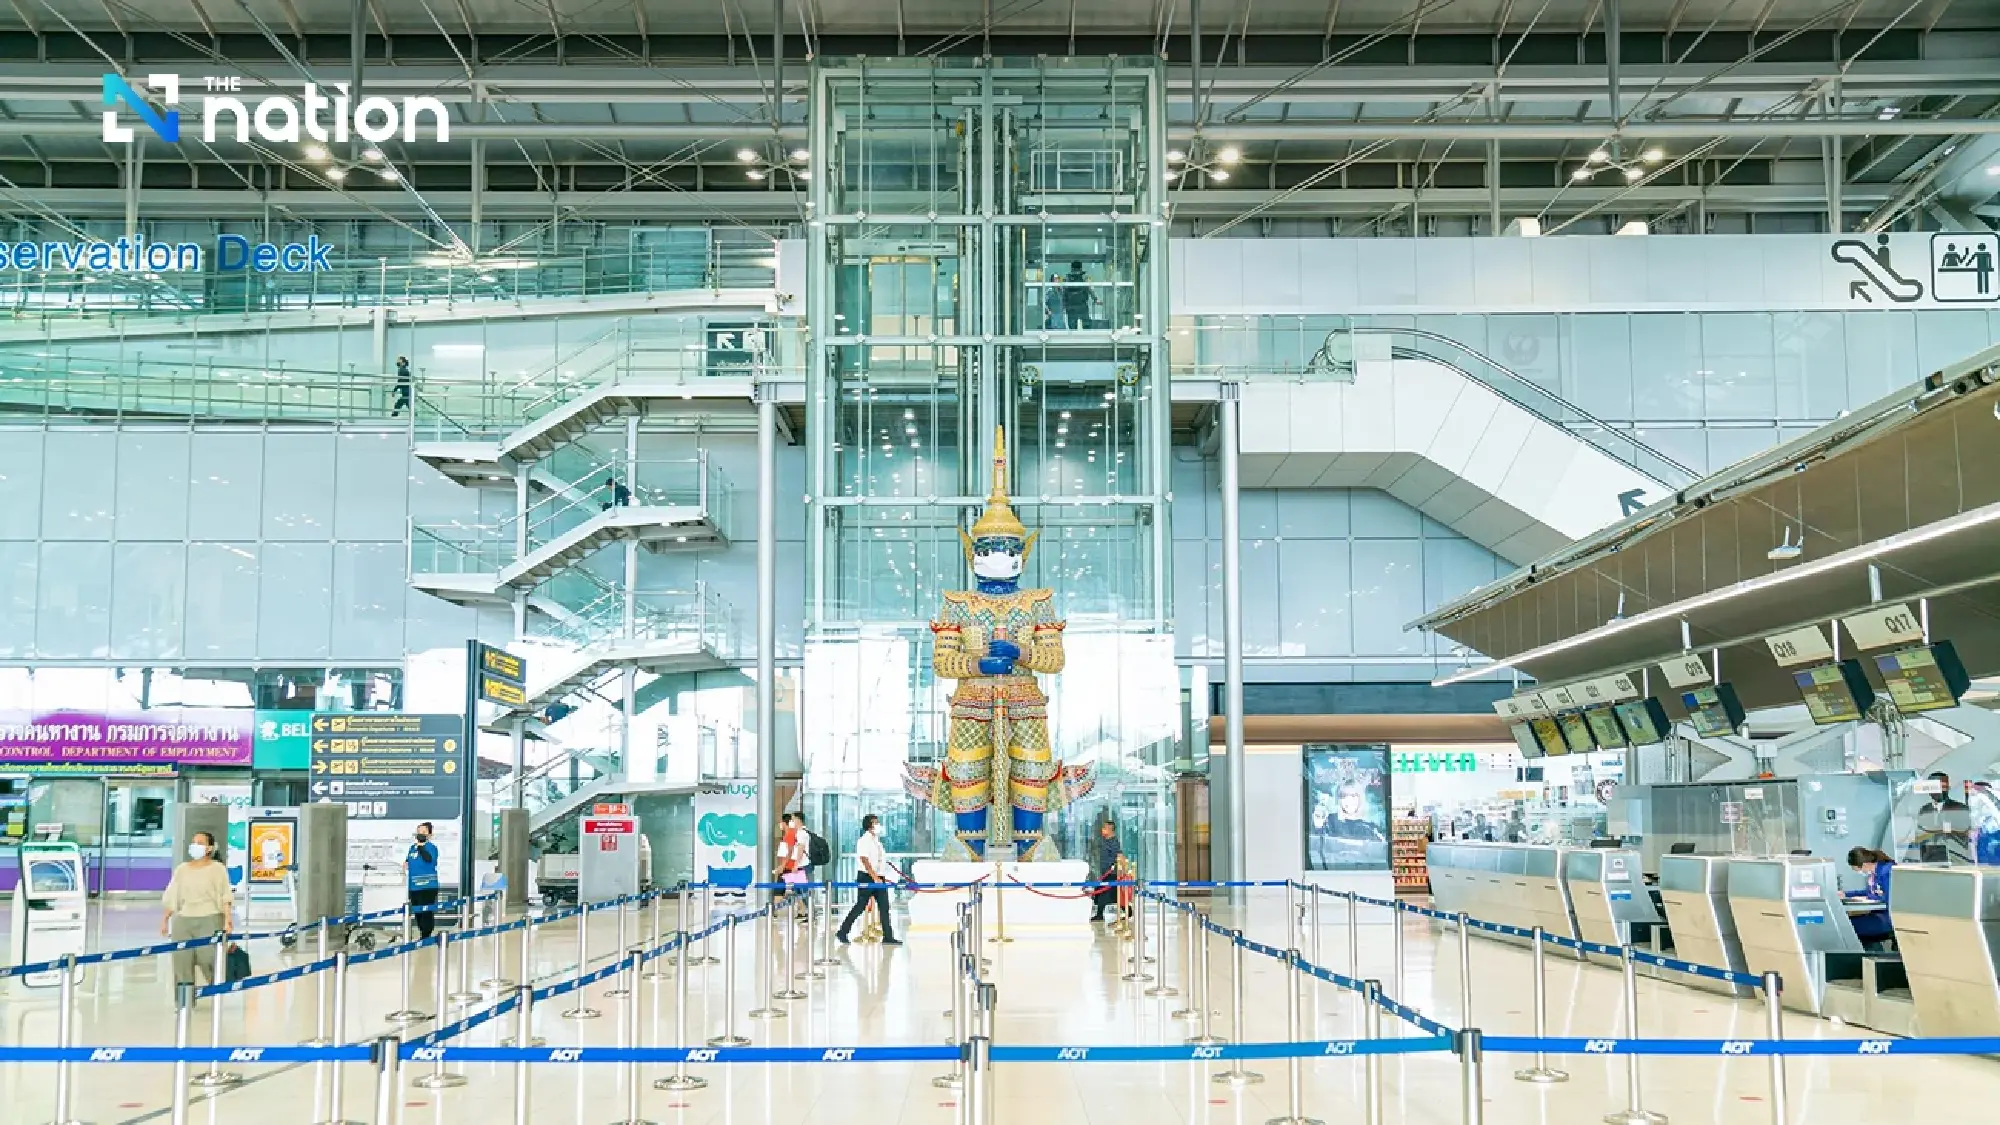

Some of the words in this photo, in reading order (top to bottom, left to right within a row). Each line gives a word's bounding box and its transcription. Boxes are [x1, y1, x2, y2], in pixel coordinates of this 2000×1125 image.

[217, 233, 335, 272] Deck
[1884, 613, 1911, 633] Q17
[62, 746, 138, 757] DEPARTMENT
[142, 746, 157, 757] OF
[160, 746, 239, 757] EMPLOYMENT
[1057, 1047, 1089, 1060] AOT
[1191, 1046, 1223, 1058] AOT
[1324, 1042, 1356, 1054] AOT
[1584, 1040, 1617, 1053] AOT
[1721, 1040, 1754, 1054] AOT
[1858, 1040, 1892, 1054] AOT
[90, 1048, 126, 1061] AOT
[228, 1048, 264, 1061] AOT
[549, 1048, 583, 1061] AOT
[686, 1048, 719, 1061] AOT
[822, 1048, 856, 1061] AOT
